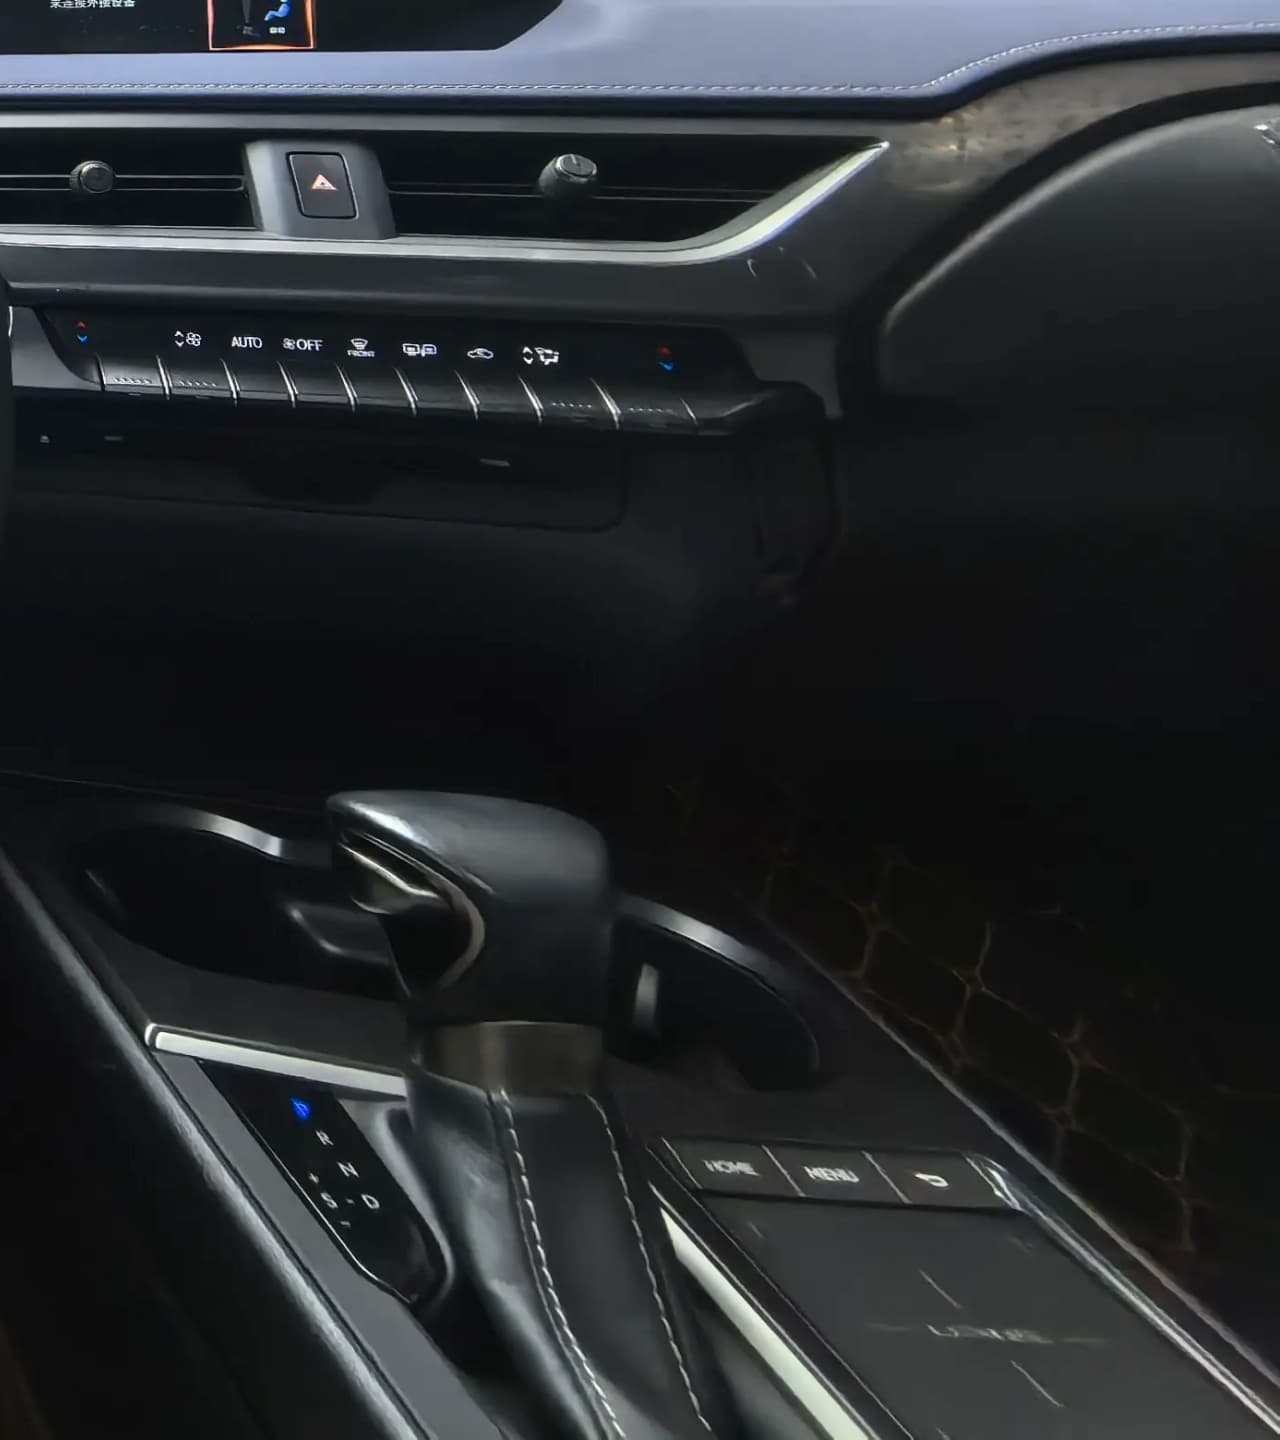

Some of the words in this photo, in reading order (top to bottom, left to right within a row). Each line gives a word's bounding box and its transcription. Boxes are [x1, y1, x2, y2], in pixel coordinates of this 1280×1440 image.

[231, 335, 264, 350] AUTO
[296, 338, 324, 352] OFF
[315, 1129, 334, 1147] R
[337, 1161, 360, 1178] N
[702, 1159, 761, 1177] HOME
[802, 1165, 860, 1184] MENU
[320, 1192, 339, 1210] S
[361, 1193, 381, 1210] D
